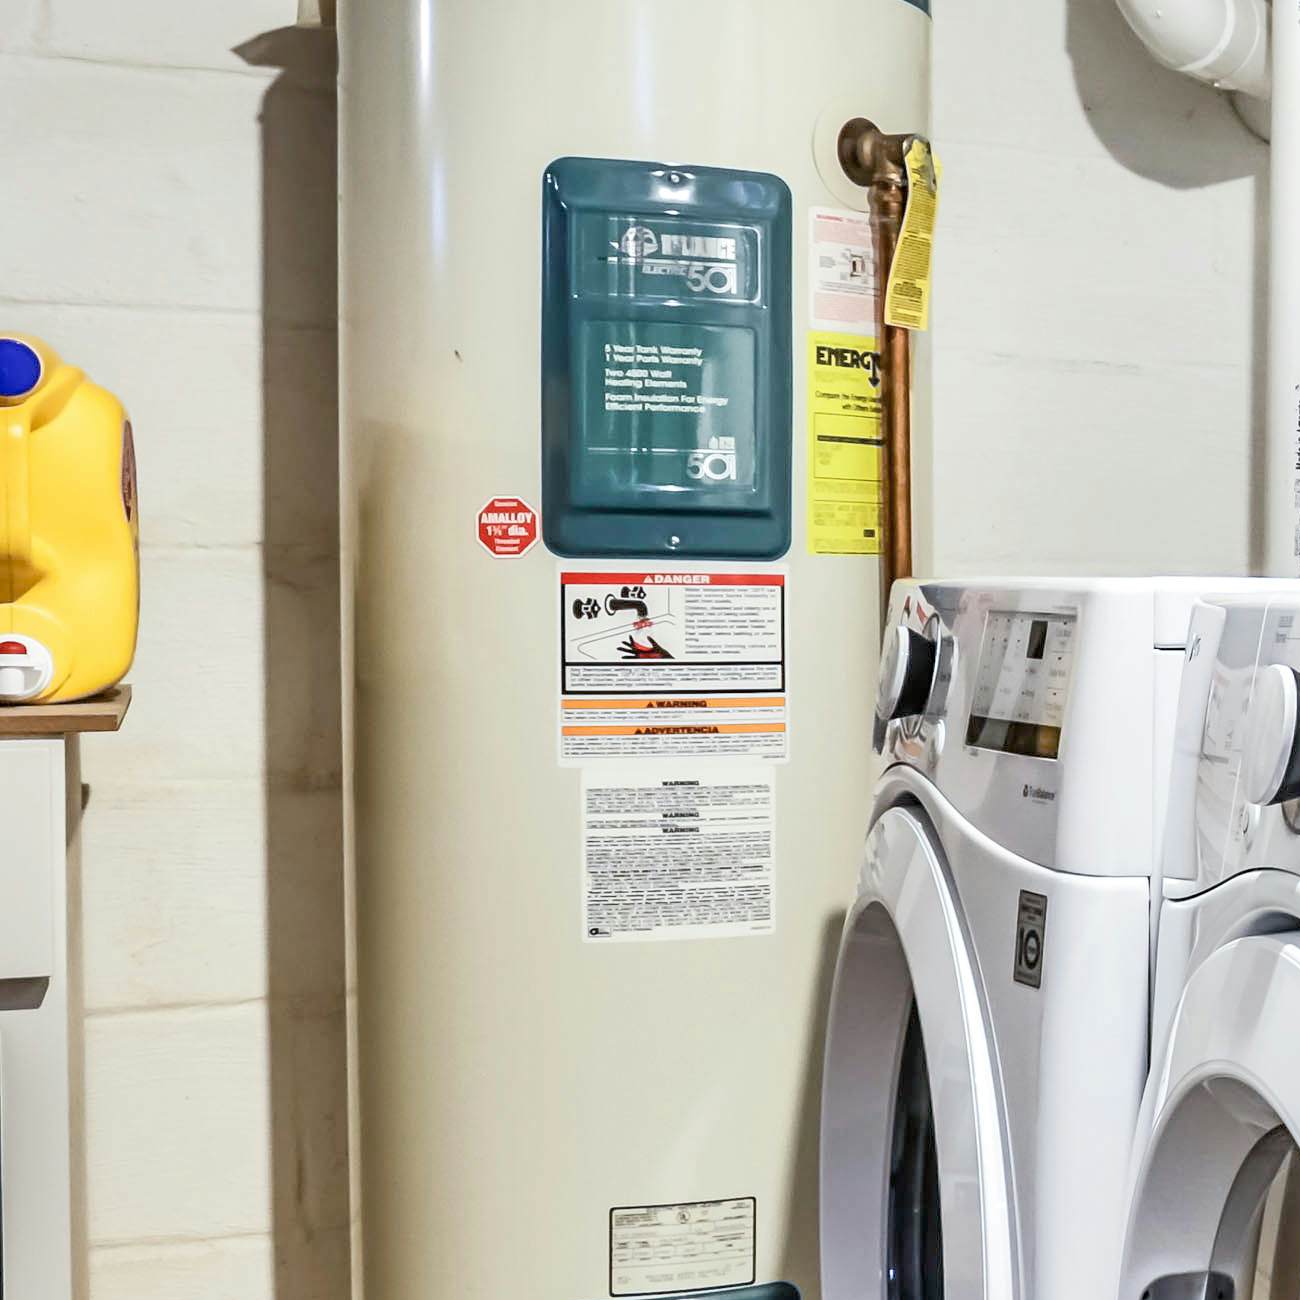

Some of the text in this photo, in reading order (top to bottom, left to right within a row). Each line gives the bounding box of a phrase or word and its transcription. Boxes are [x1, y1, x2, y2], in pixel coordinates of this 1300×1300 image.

[686, 263, 737, 295] 501
[686, 453, 737, 480] 501
[480, 512, 533, 524] AMALLOY
[654, 574, 710, 585] DANGER
[656, 700, 708, 709] WARNING
